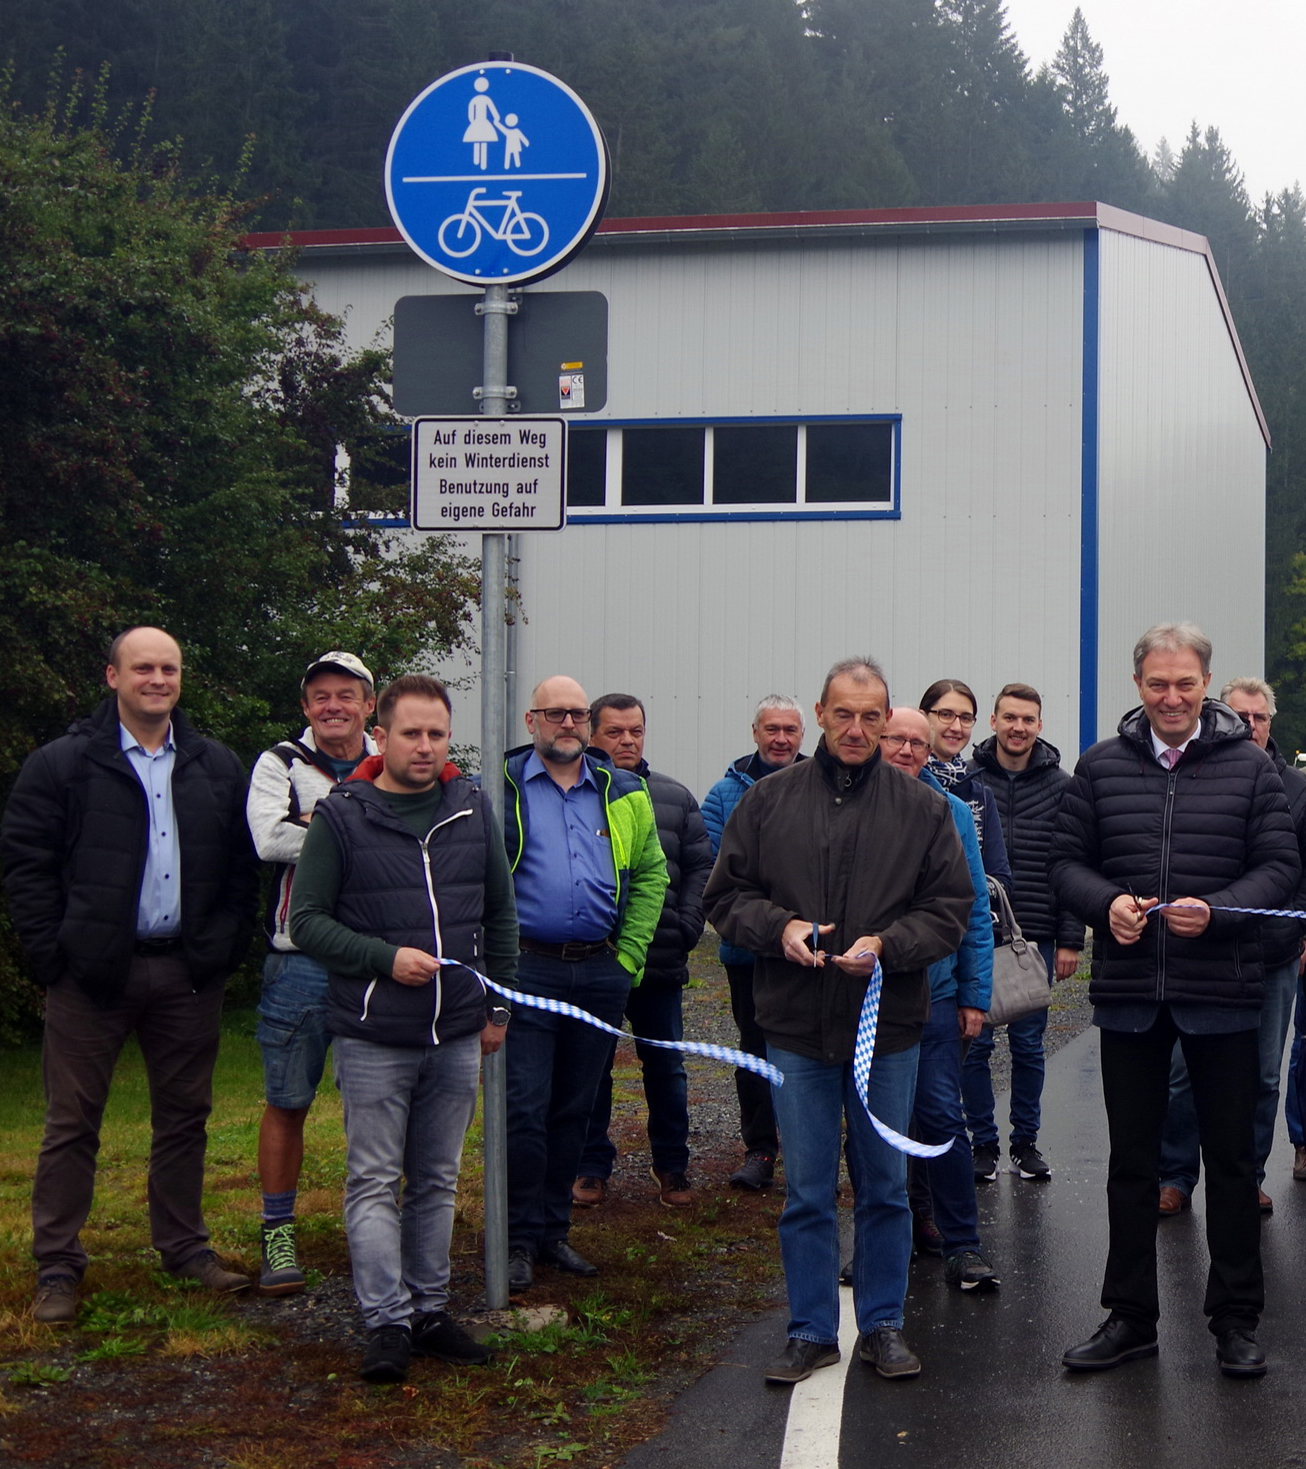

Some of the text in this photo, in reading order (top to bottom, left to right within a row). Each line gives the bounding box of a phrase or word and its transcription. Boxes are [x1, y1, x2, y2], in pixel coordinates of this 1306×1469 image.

[433, 429, 547, 449] Auf diesem Weg
[429, 452, 550, 469] kein Winterdienst
[439, 478, 539, 498] Benutzung auf
[440, 501, 537, 522] eigene Gefahr
